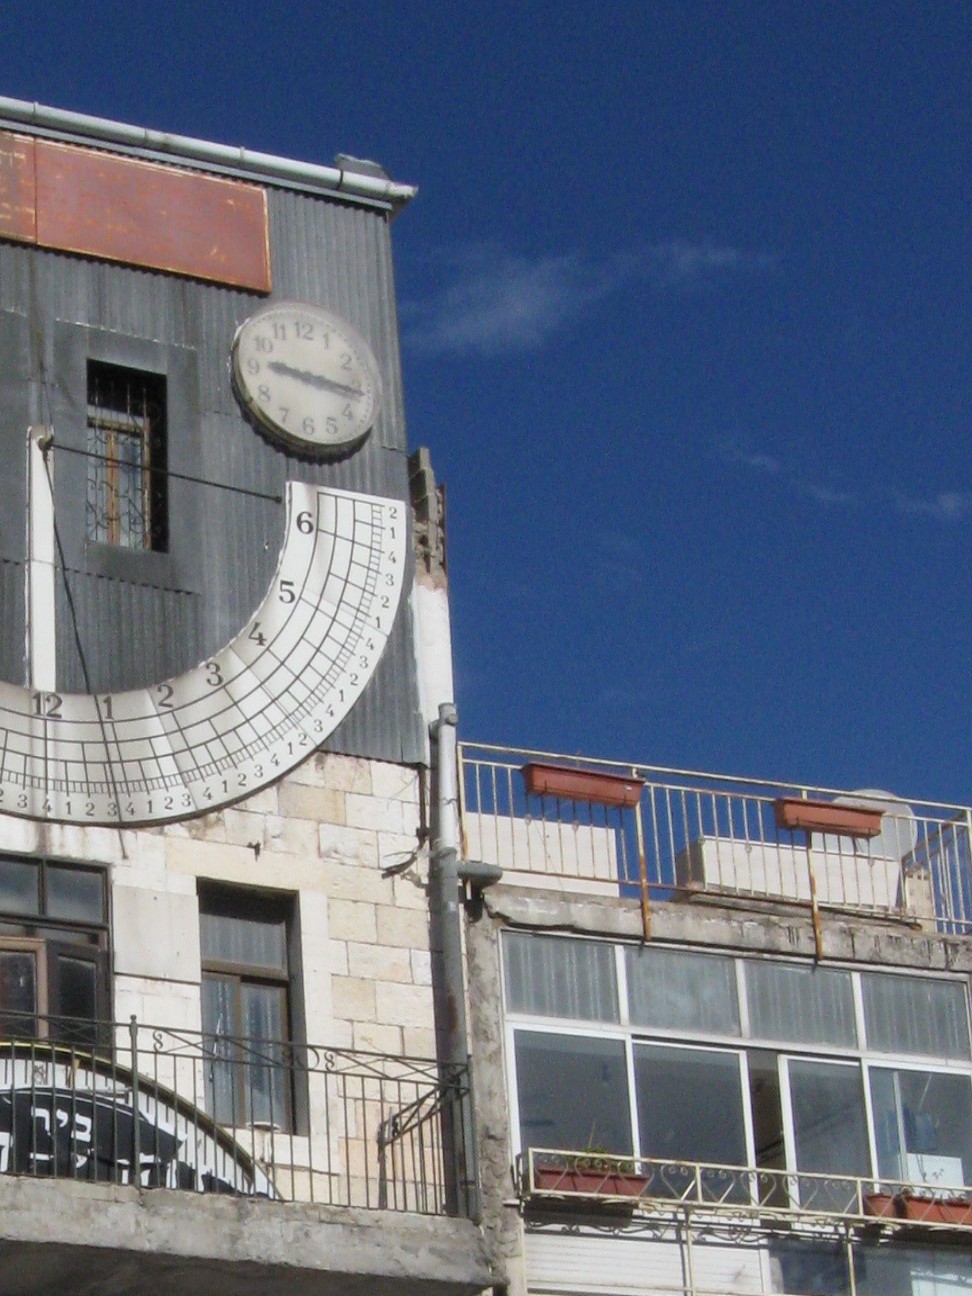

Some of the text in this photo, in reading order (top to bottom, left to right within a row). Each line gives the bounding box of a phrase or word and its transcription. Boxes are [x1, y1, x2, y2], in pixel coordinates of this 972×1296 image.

[247, 321, 353, 435] 12 1 2 4 5 6 7 8 9 10 11
[388, 507, 398, 519] 2
[389, 527, 396, 539] 1
[388, 551, 397, 564] 4
[385, 574, 395, 586] 3
[380, 596, 390, 608] 2
[32, 692, 63, 719] 12
[102, 695, 114, 720] 1
[157, 684, 174, 708] 2
[205, 661, 224, 687] 3
[247, 621, 267, 647] 4
[278, 579, 296, 604] 5
[295, 510, 316, 535] 6
[375, 616, 381, 629] 1
[365, 638, 375, 650] 4
[359, 656, 369, 668] 3
[349, 673, 359, 686] 2
[338, 689, 345, 702] 1
[325, 704, 335, 717] 4
[313, 720, 324, 732] 3
[298, 732, 308, 745] 2
[287, 742, 294, 755] 1
[270, 753, 280, 766] 4
[253, 765, 264, 778] 3
[221, 780, 229, 793] 1
[237, 773, 247, 787] 2
[181, 793, 191, 806] 3
[202, 787, 214, 800] 4
[16, 795, 28, 808] 3
[42, 799, 52, 812] 4
[147, 800, 153, 814] 1
[163, 797, 174, 810] 2
[65, 802, 72, 815] 1
[85, 802, 96, 816] 2
[107, 803, 117, 816] 3
[125, 802, 136, 815] 4
